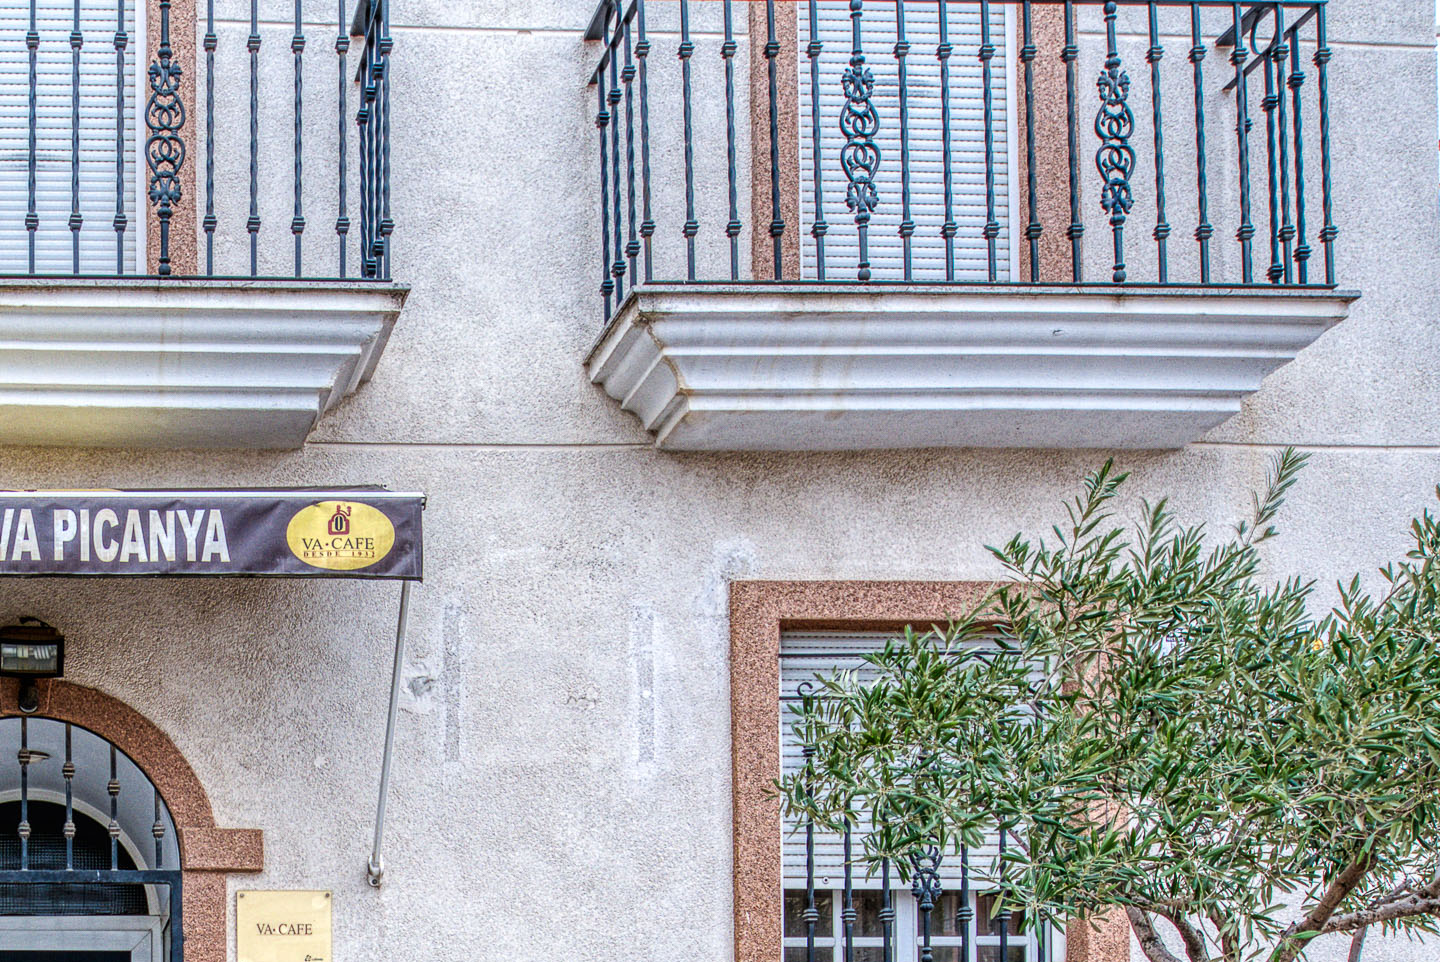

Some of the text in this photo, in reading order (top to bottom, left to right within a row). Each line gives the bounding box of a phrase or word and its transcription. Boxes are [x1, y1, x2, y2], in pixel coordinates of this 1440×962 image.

[53, 508, 231, 563] PICANYA
[331, 537, 375, 550] CAFE
[278, 923, 313, 935] CAFE
